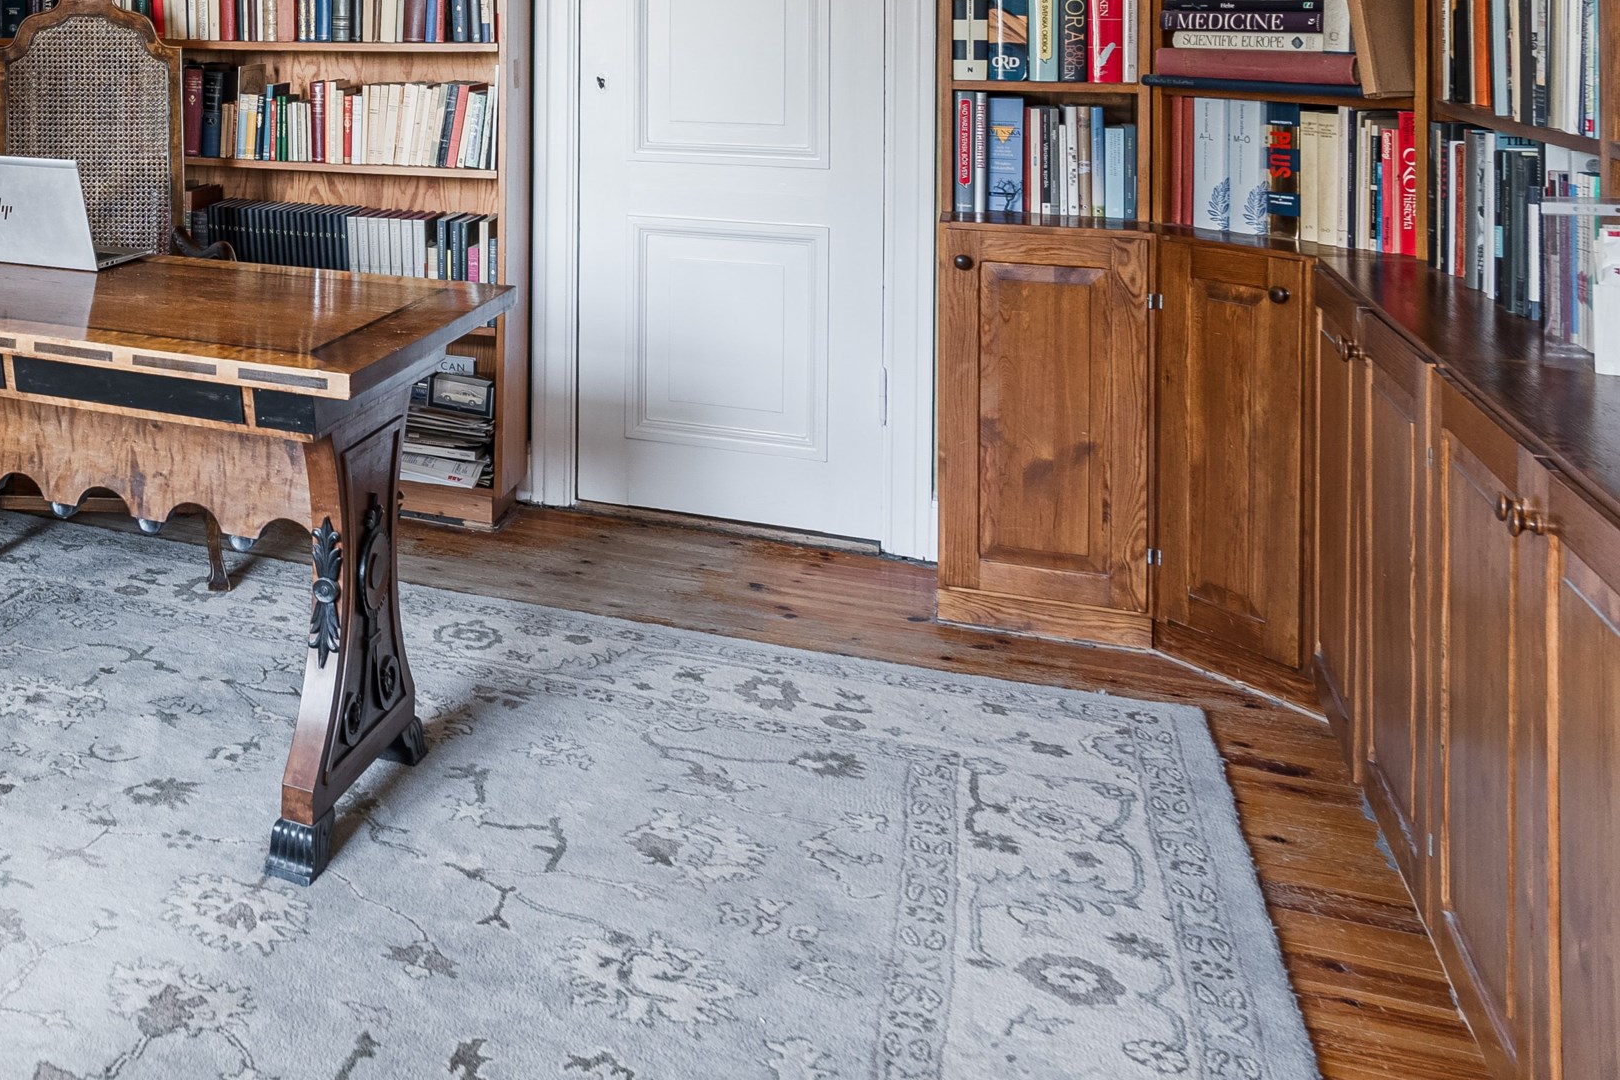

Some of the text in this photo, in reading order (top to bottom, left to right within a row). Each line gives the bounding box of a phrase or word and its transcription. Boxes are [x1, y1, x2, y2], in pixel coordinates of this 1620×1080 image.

[1041, 4, 1049, 29] SVENSKA
[1176, 13, 1284, 31] MEDICINE
[1041, 30, 1049, 54] ORDBOK
[1182, 34, 1285, 48] SCIENTIFIC EUROPE
[991, 55, 1020, 70] ORD
[1064, 44, 1075, 80] BOKEN
[1269, 130, 1292, 178] PLUS
[1382, 131, 1392, 160] Grafologi
[1403, 193, 1415, 230] historia
[209, 223, 346, 239] NATIONALENCYKLOPEDIN
[440, 361, 465, 372] CAN
